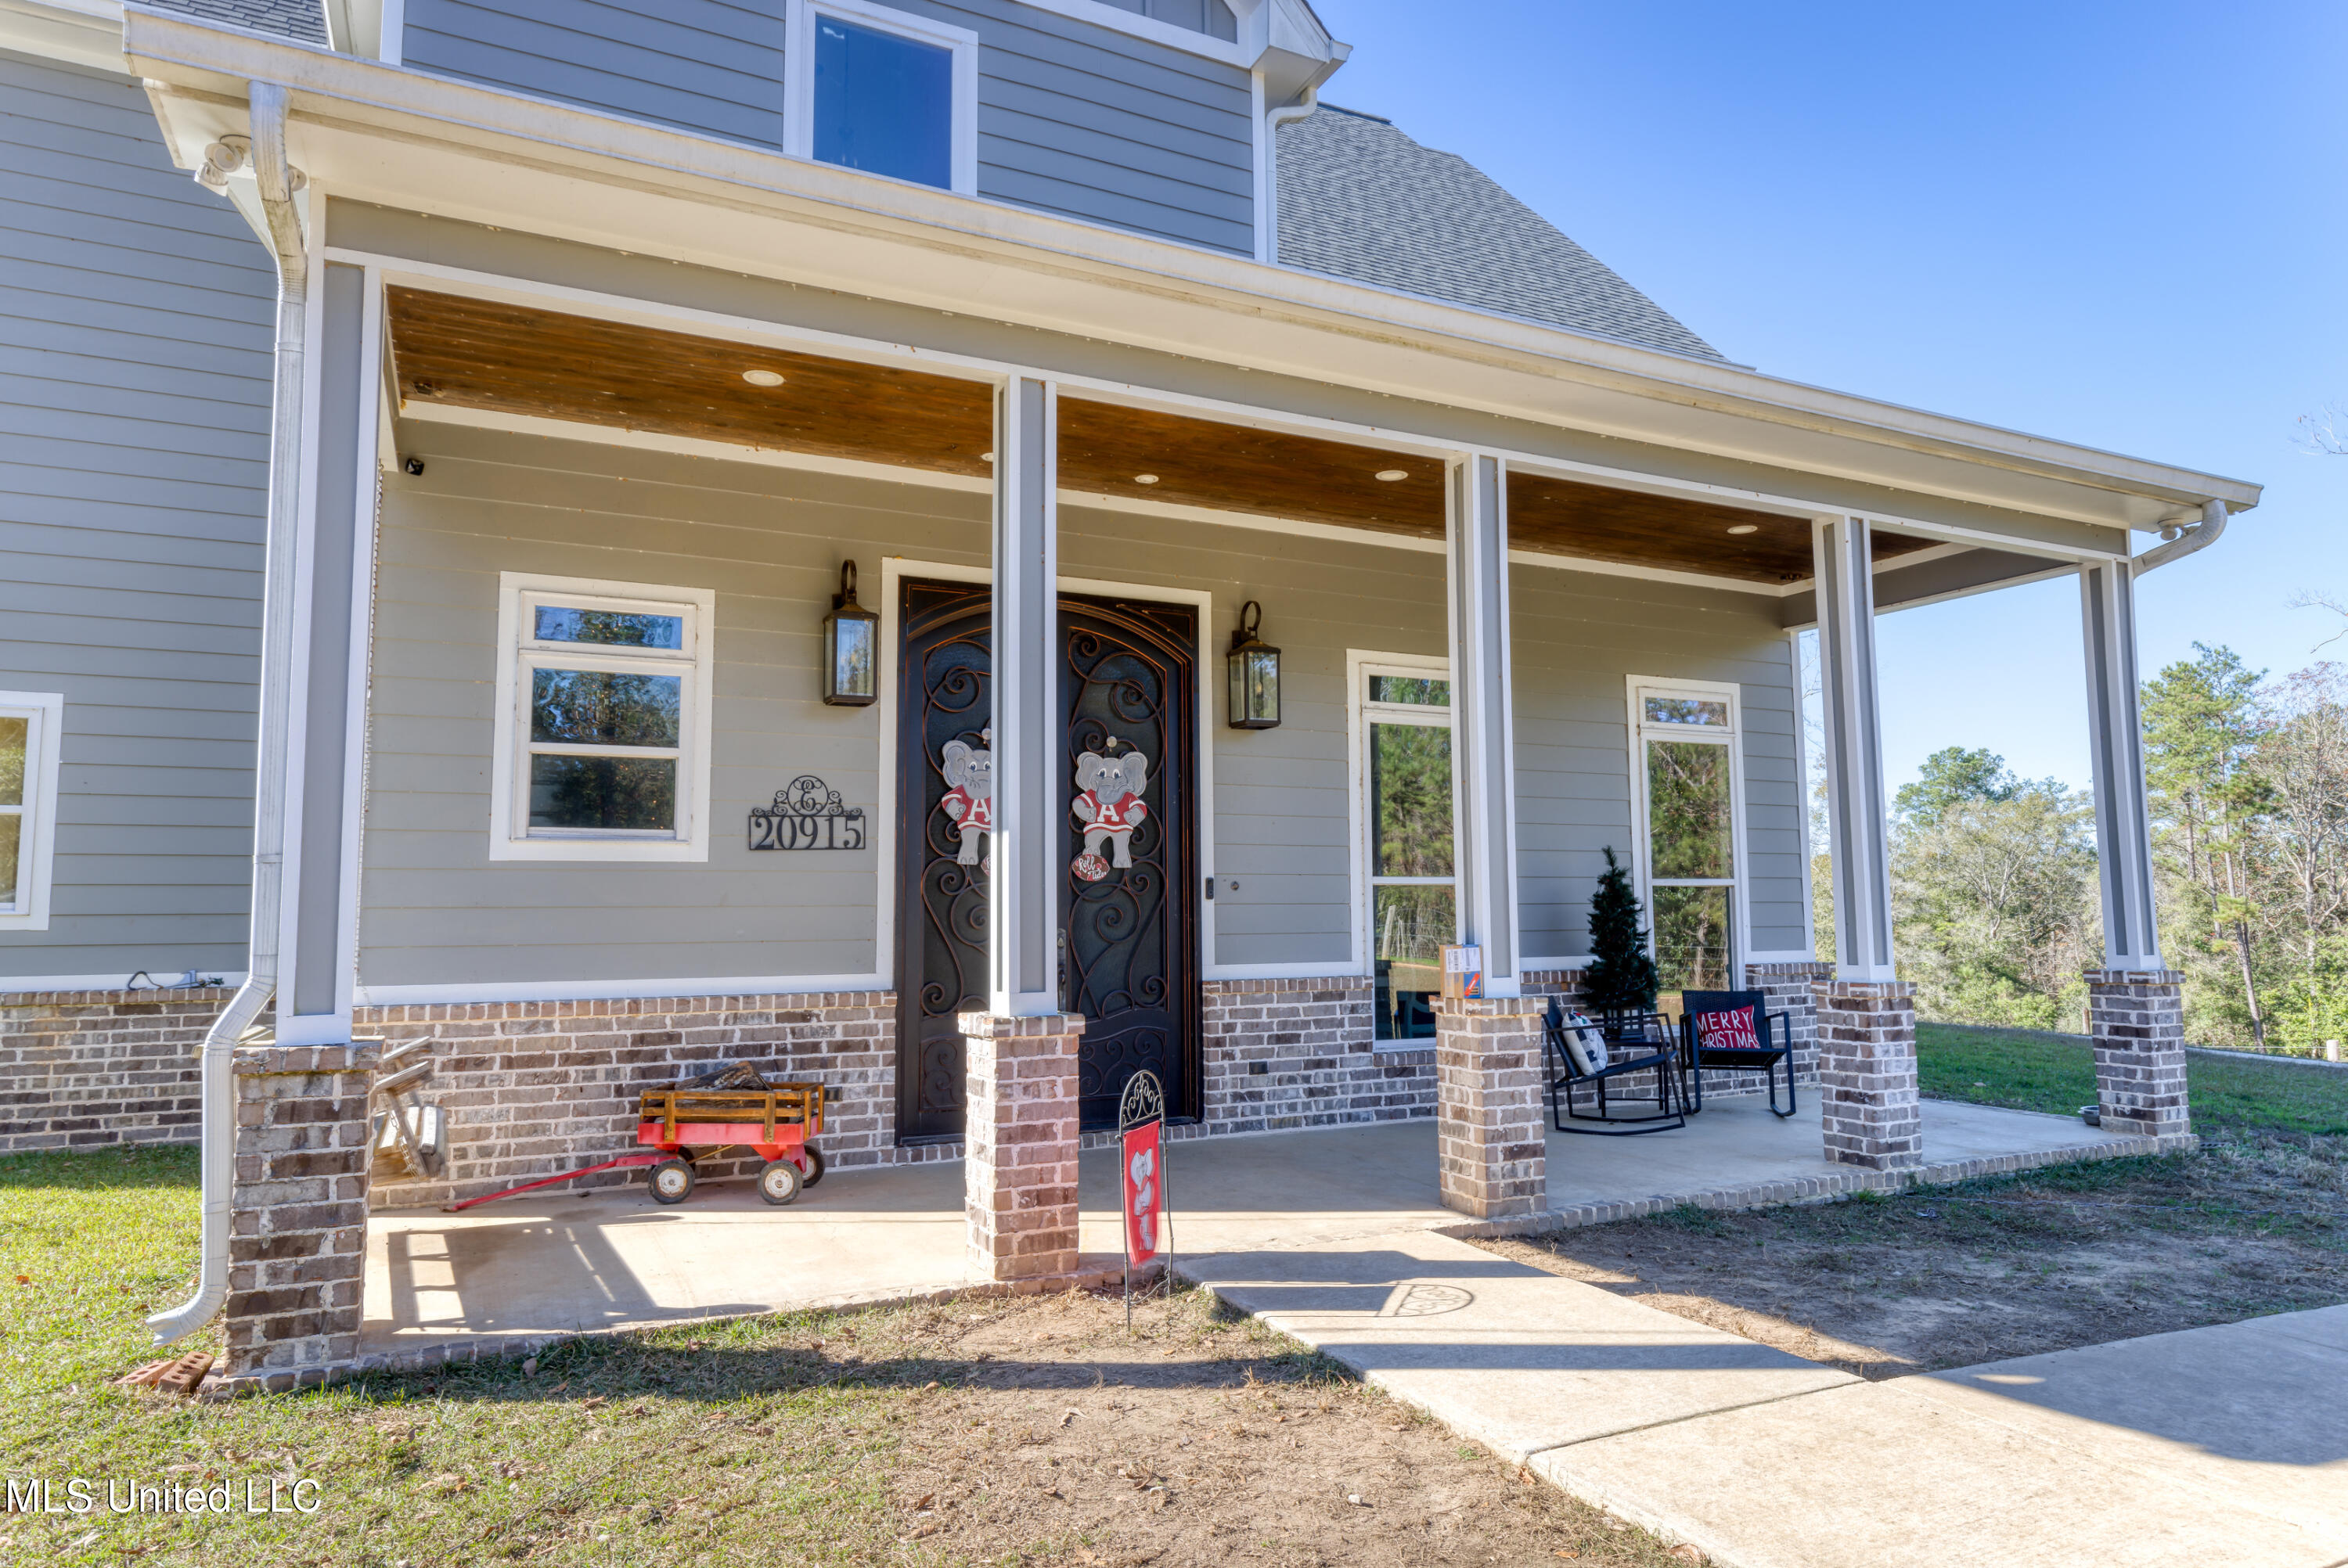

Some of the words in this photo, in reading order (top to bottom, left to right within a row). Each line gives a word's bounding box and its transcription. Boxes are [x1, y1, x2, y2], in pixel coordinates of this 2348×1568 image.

[967, 799, 991, 822] A
[1097, 804, 1119, 822] A
[754, 815, 861, 850] 20915
[1079, 855, 1095, 873] Roll
[1696, 1010, 1751, 1035] MERRY
[1699, 1030, 1761, 1048] HRISTMAS
